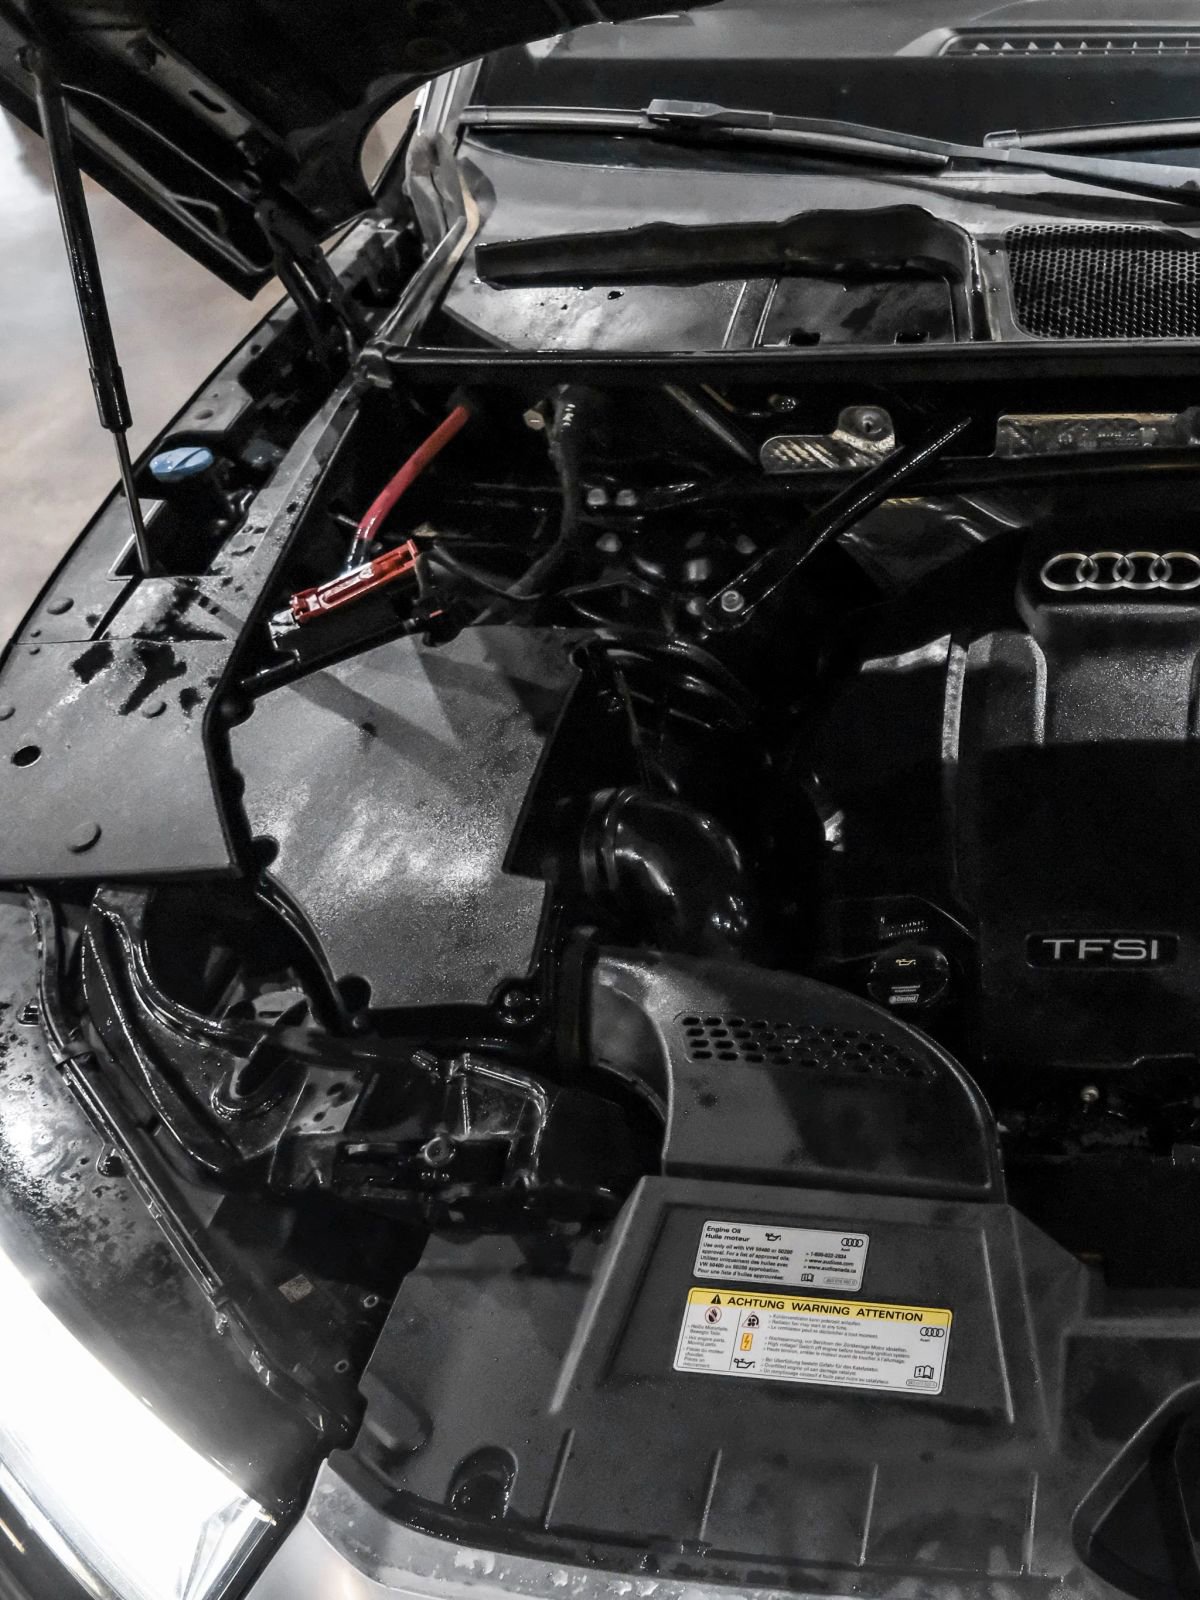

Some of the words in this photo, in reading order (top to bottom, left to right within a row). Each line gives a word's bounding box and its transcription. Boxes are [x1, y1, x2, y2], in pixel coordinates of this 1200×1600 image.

[1042, 939, 1158, 960] TFSI
[728, 1296, 785, 1310] ACHTUNG
[792, 1302, 850, 1316] WARNING
[856, 1308, 923, 1322] ATTENTION
